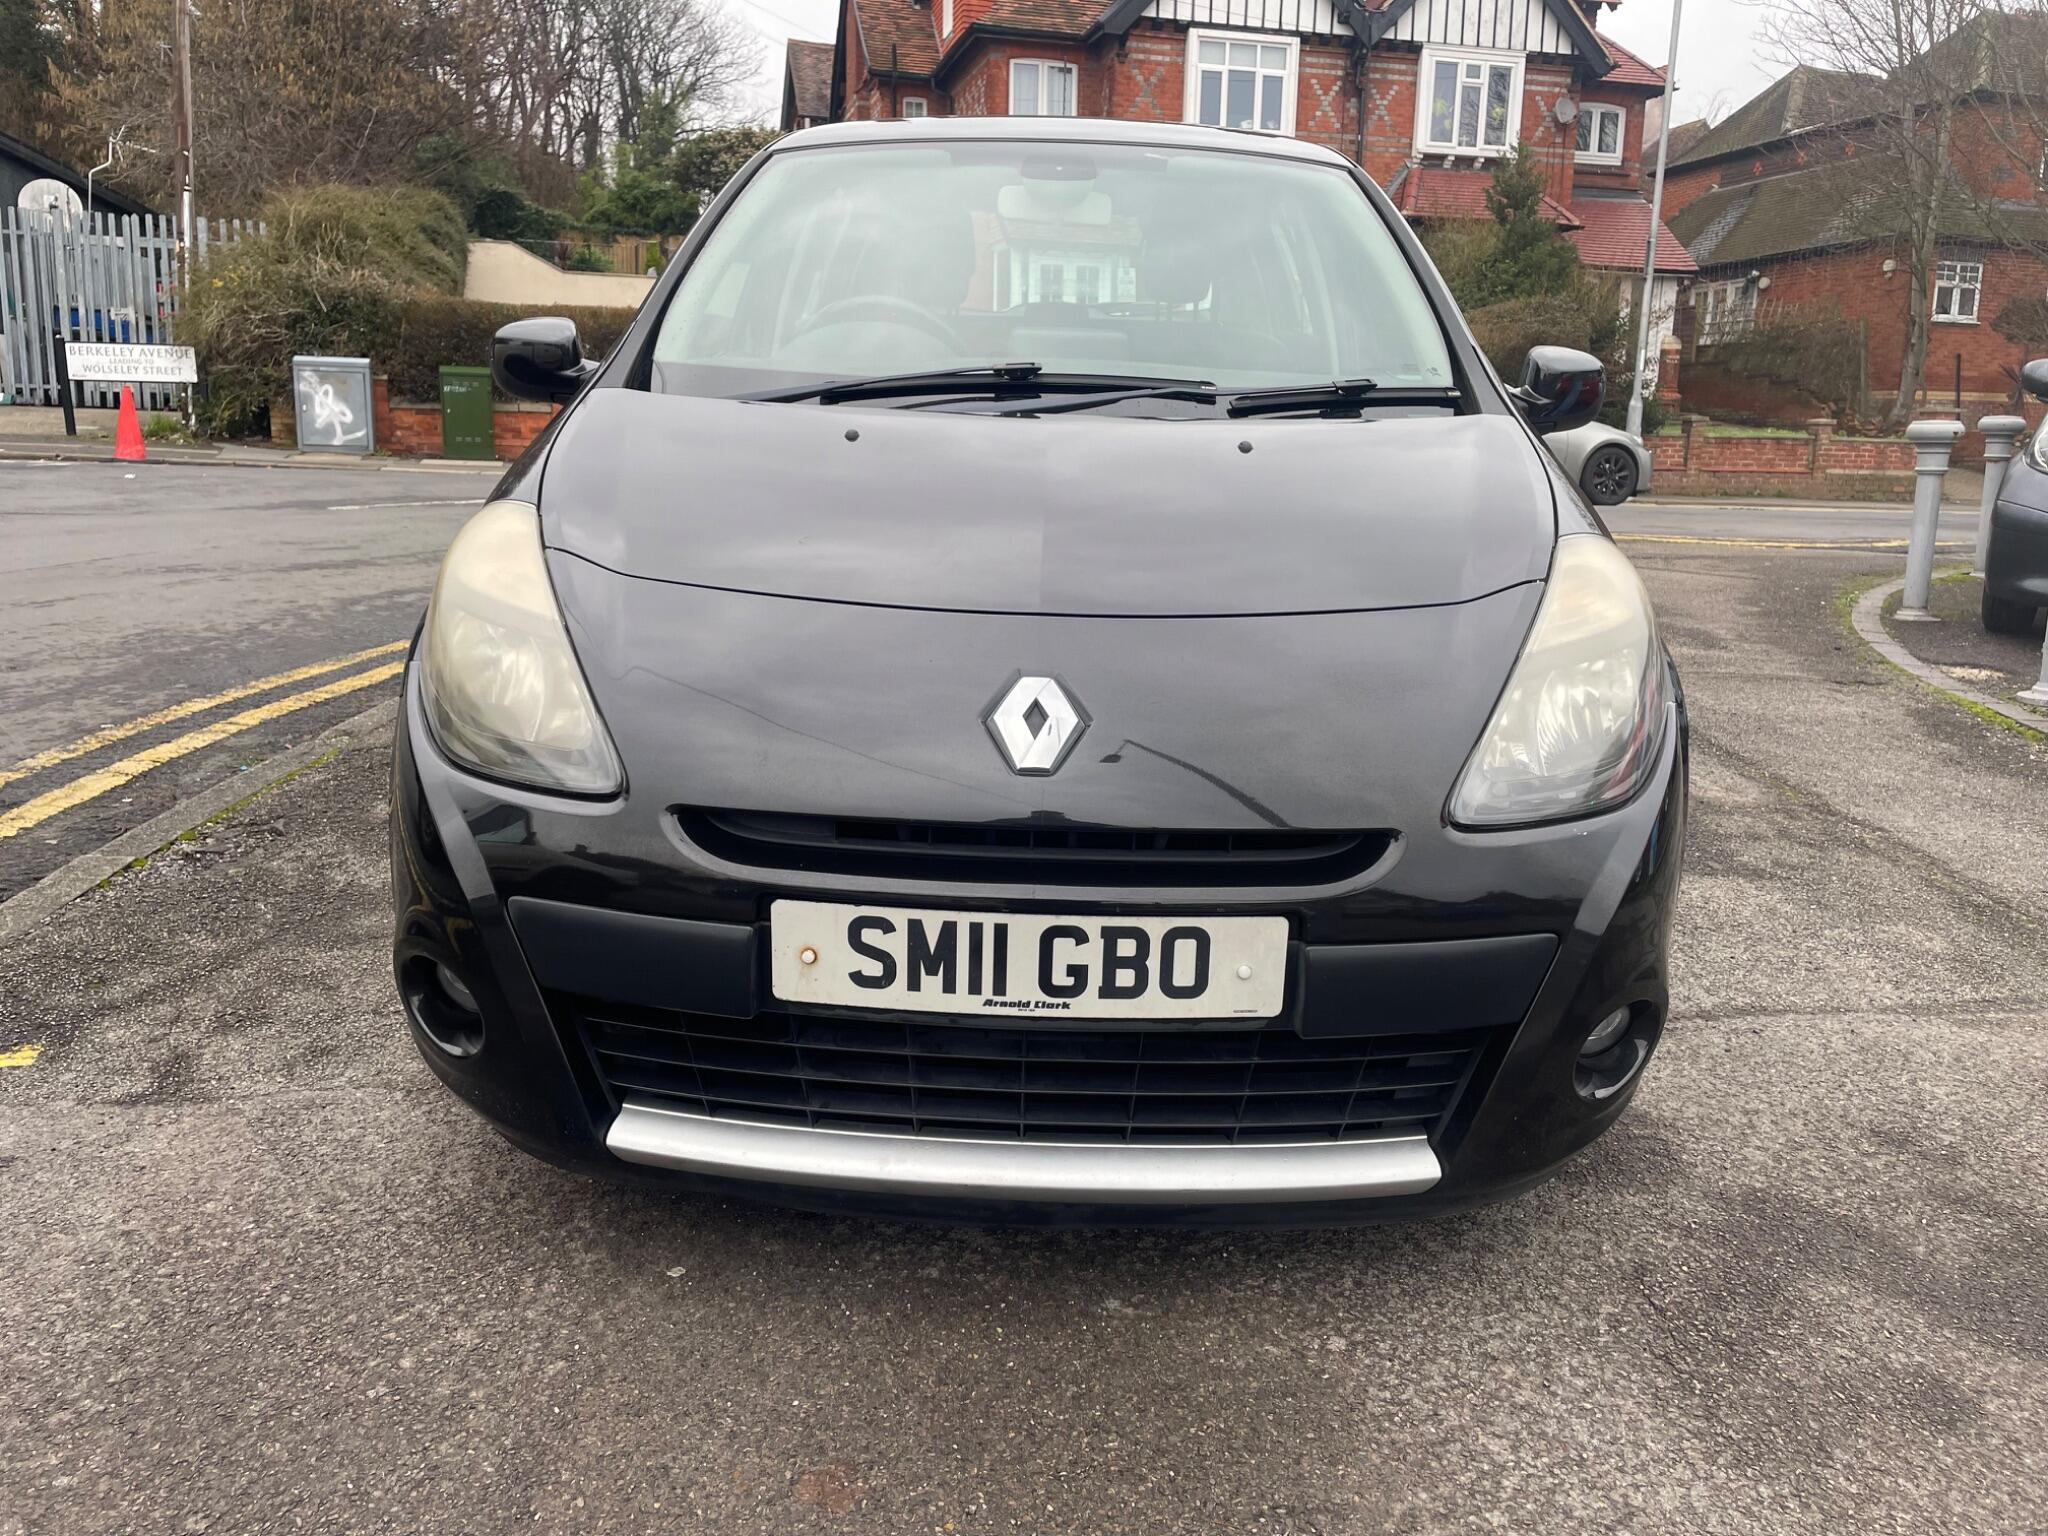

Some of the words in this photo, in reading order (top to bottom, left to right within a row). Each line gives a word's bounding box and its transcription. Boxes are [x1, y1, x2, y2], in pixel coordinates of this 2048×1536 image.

[69, 346, 134, 357] BERKELEY
[140, 348, 192, 359] AVENUE
[83, 364, 139, 374] WOLSELEY
[143, 366, 183, 376] STREET
[847, 915, 1008, 997] SM11
[1038, 925, 1211, 999] GBO
[982, 999, 1031, 1008] Arnold
[1034, 1001, 1071, 1010] Clark
